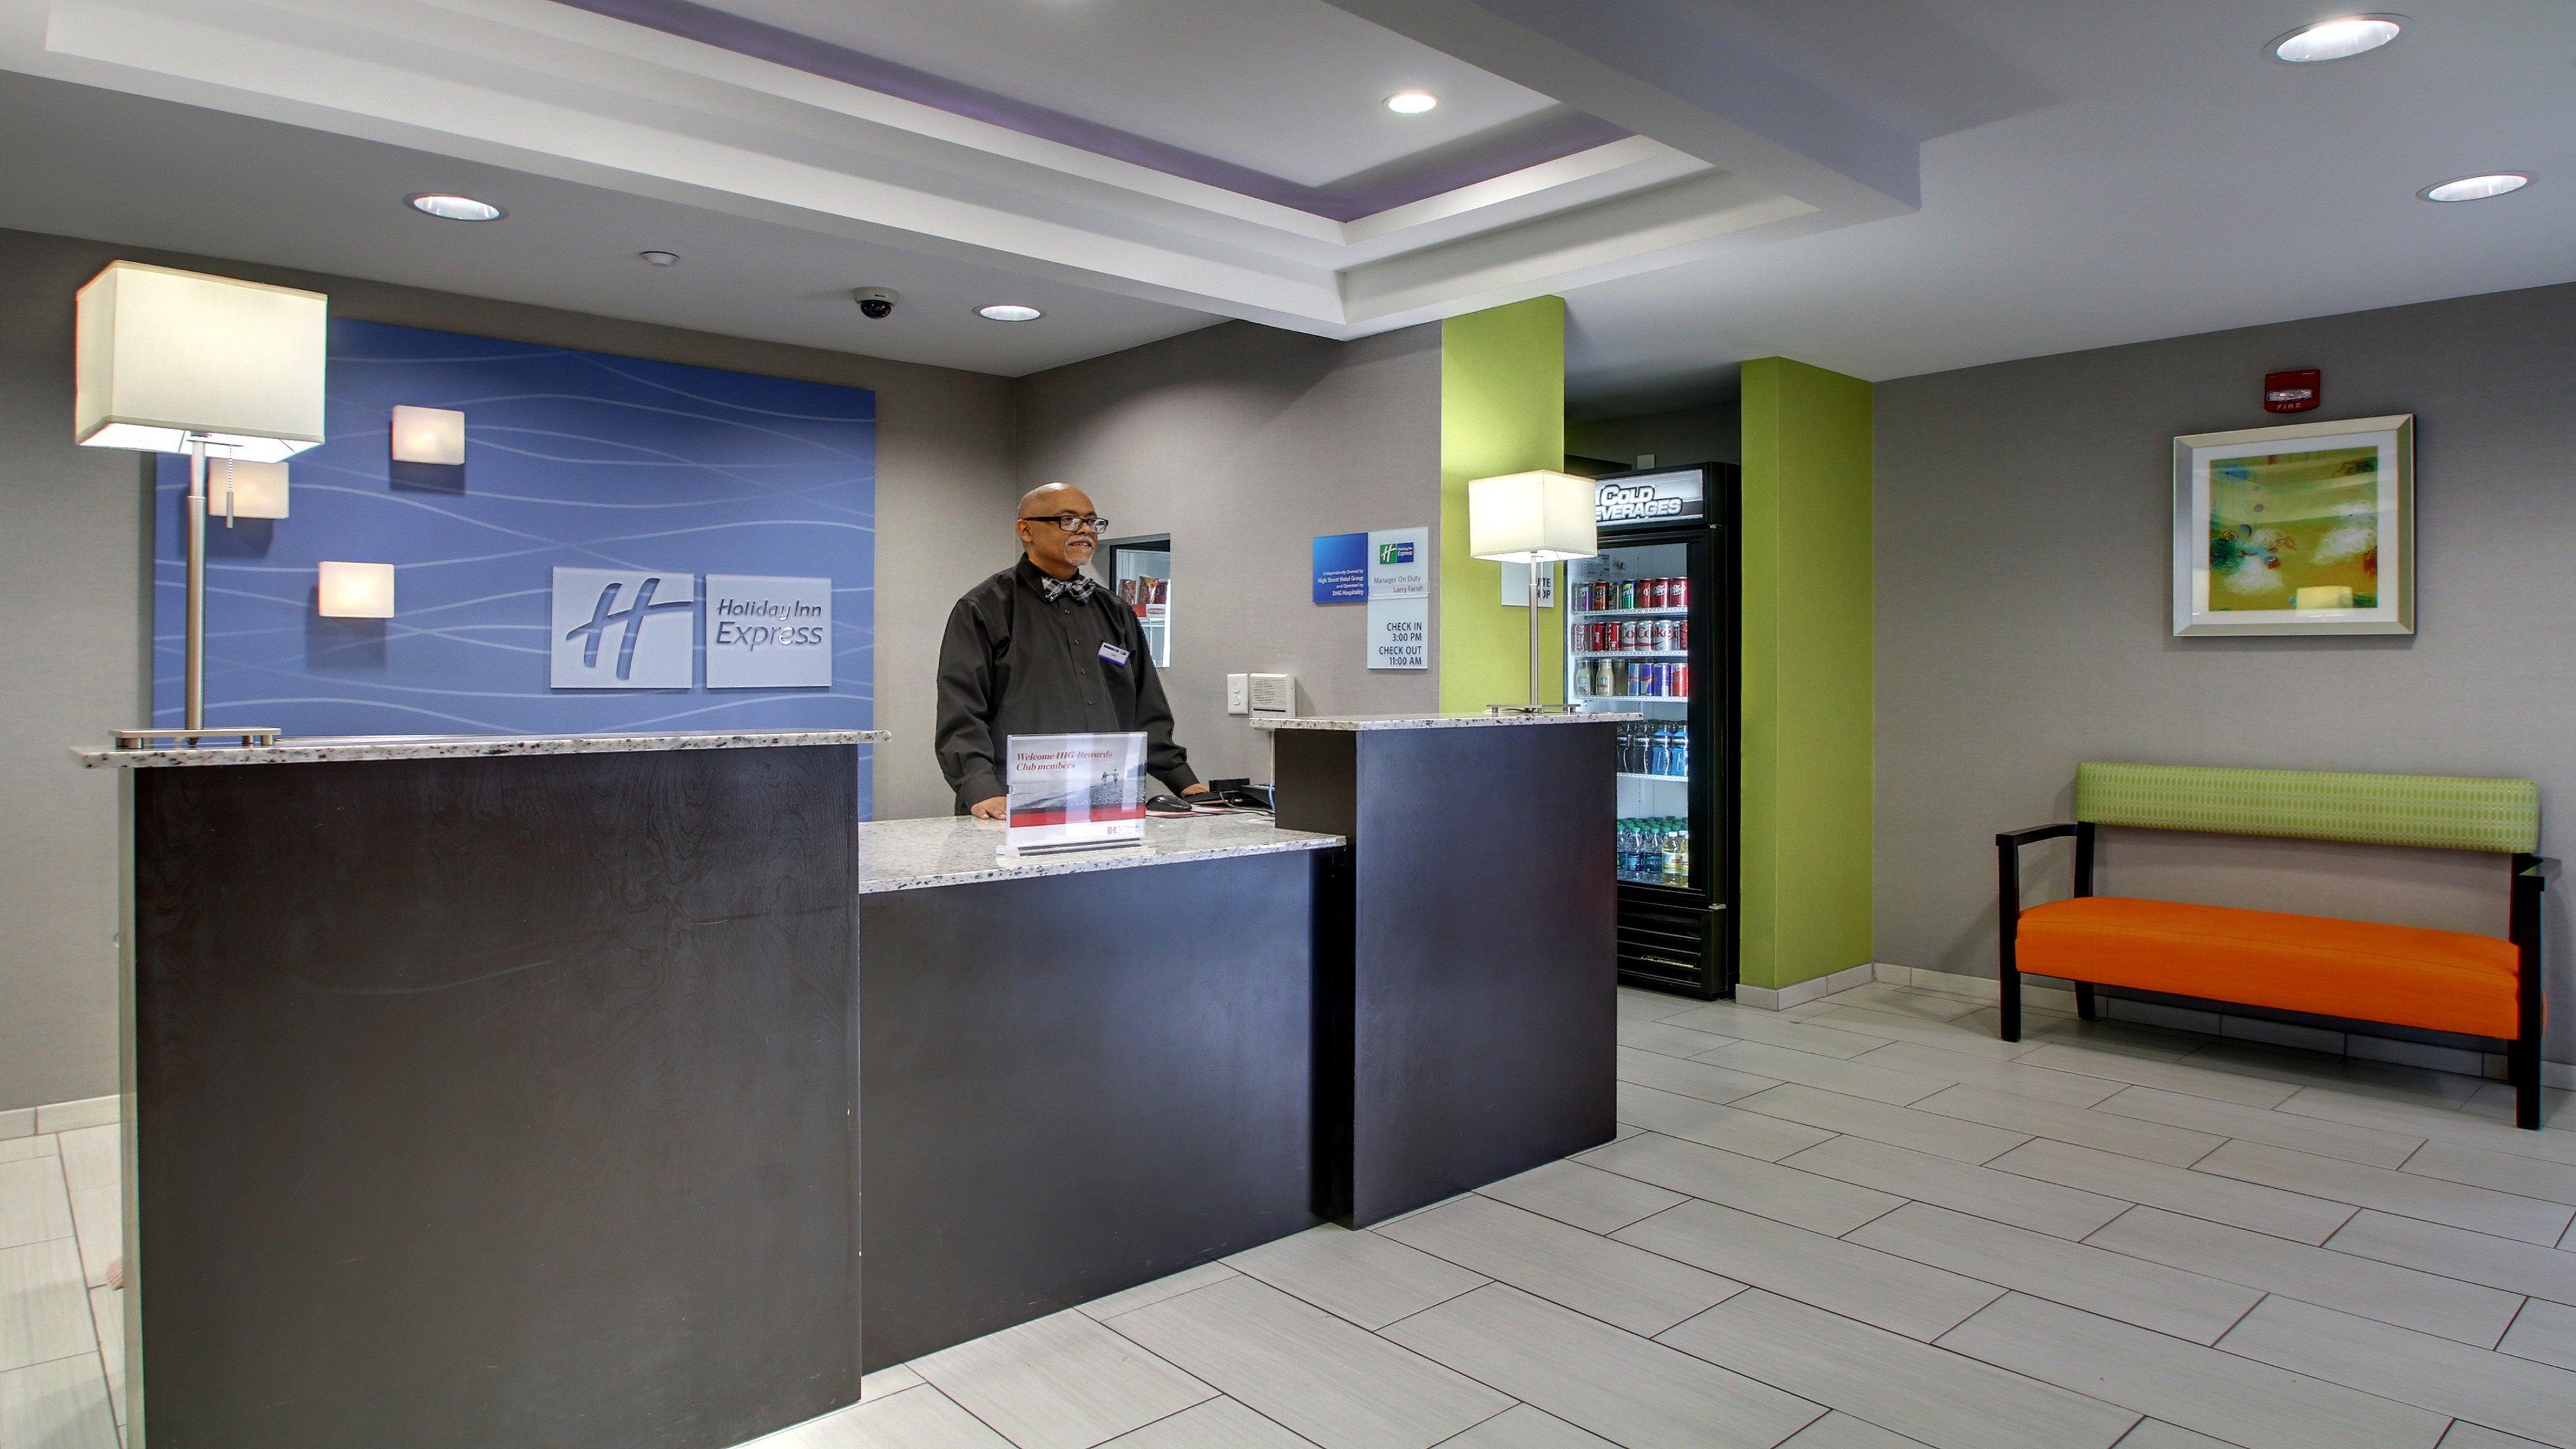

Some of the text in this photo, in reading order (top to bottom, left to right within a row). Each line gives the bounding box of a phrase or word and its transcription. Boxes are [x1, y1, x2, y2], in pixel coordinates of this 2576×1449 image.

[2276, 402, 2302, 410] FIRE
[1595, 497, 1683, 522] EVERAGES
[1407, 575, 1421, 583] Duty
[717, 598, 822, 621] Holiday Inn
[1387, 622, 1422, 631] CHECK IN
[716, 621, 823, 651] Express
[1392, 633, 1422, 641] 3:00 PM
[1379, 646, 1422, 655] CHECK OUT
[1389, 656, 1422, 665] 11:00 AM
[1017, 750, 1113, 761] Welcome IHG Rewards
[1016, 761, 1076, 771] Club members
